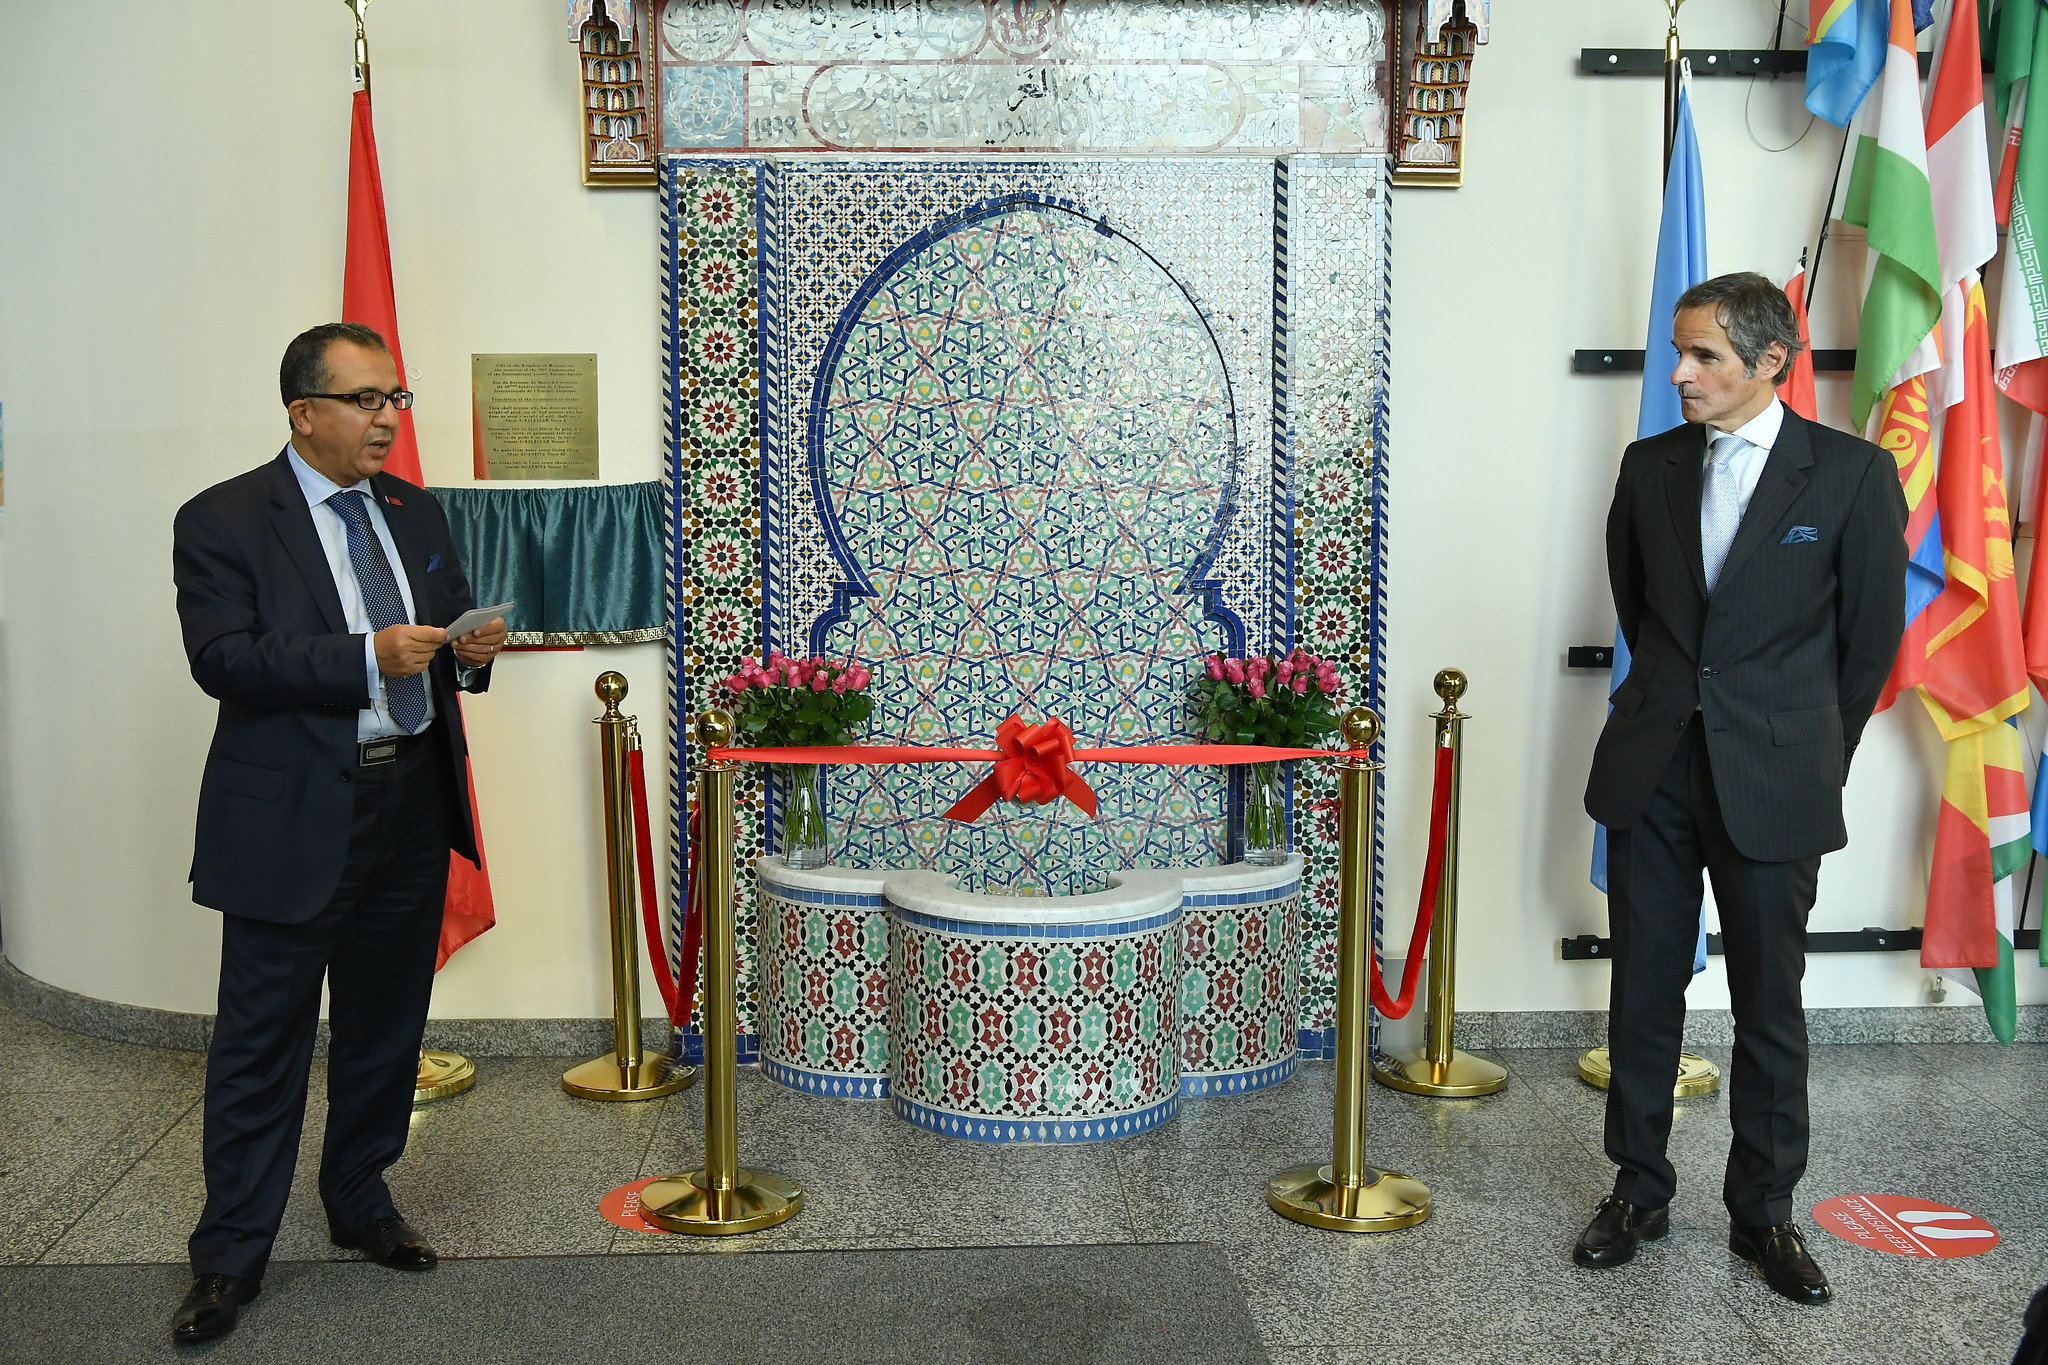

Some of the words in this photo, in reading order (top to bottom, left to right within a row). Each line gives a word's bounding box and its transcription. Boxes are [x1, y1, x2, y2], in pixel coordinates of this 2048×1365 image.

[750, 115, 798, 144] 1998
[621, 1191, 641, 1217] PLEASE
[1840, 1198, 1894, 1234] DISTANCE
[1831, 1211, 1876, 1240] PLEASE
[1886, 1234, 1920, 1255] KEEP
